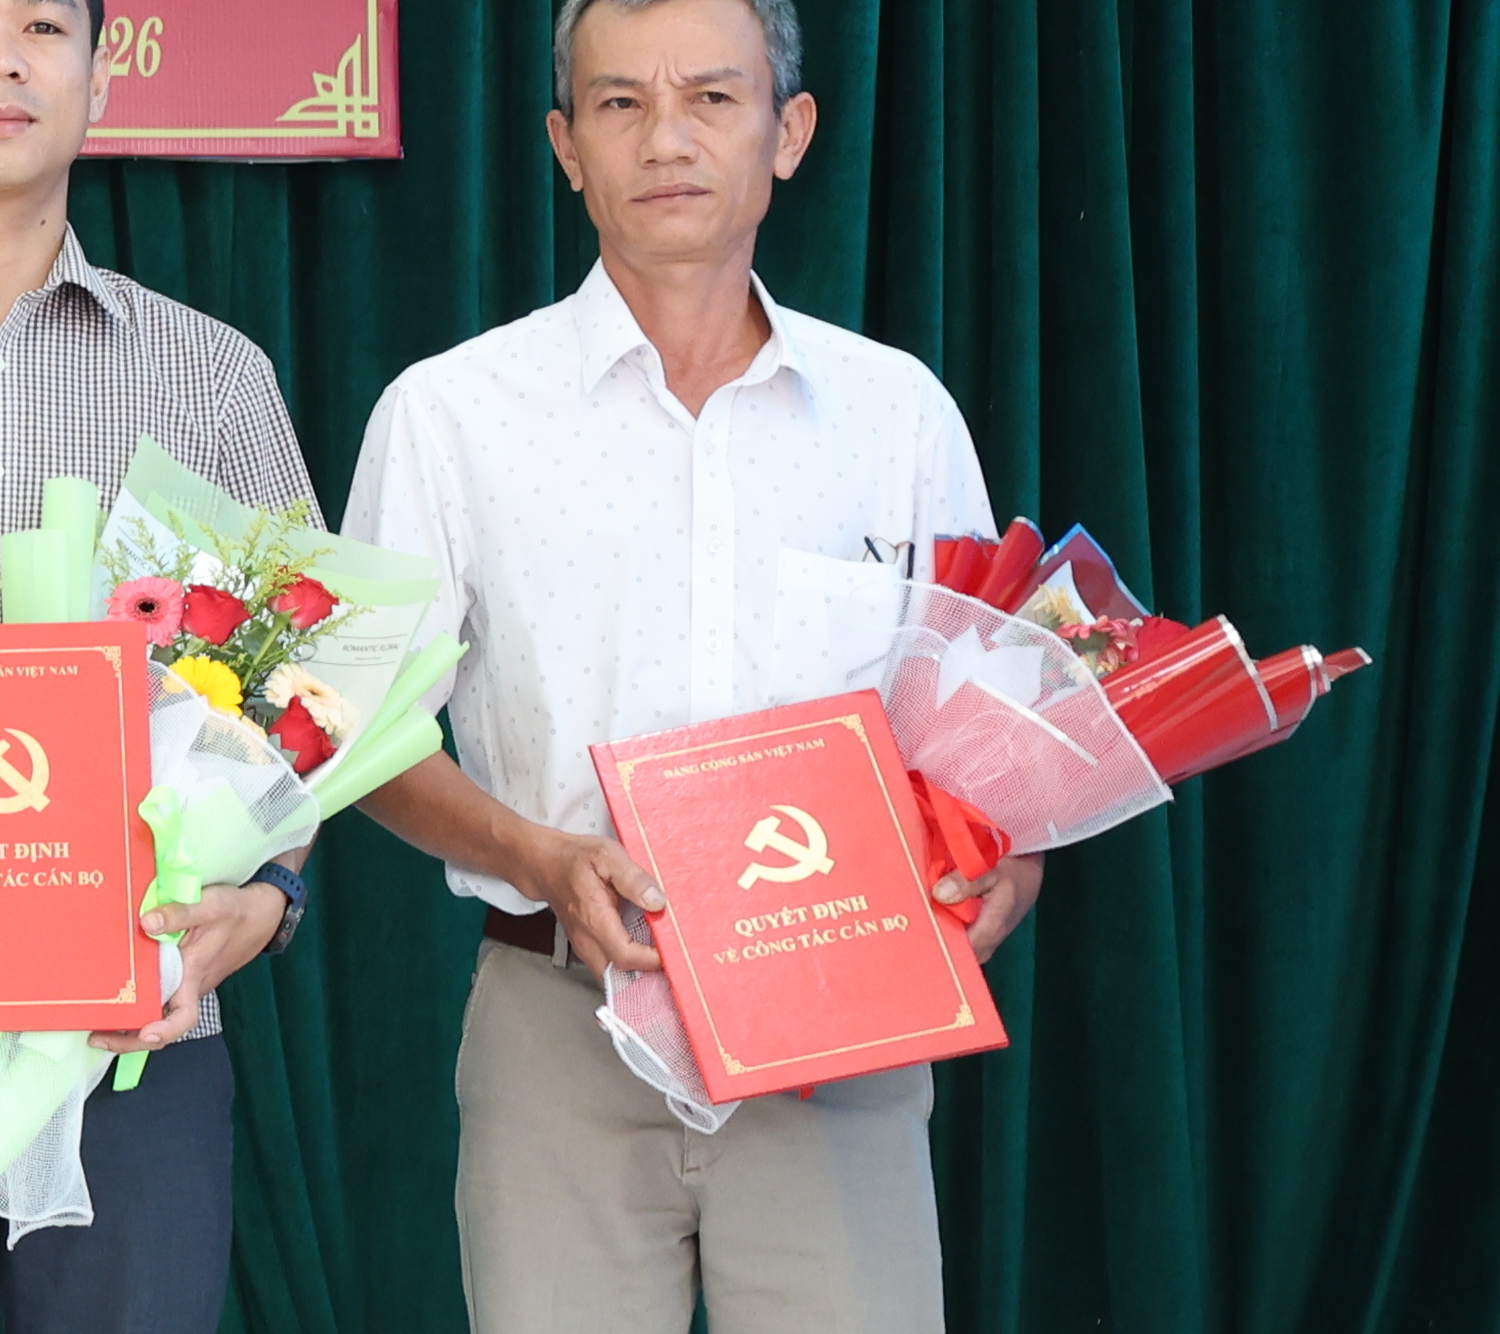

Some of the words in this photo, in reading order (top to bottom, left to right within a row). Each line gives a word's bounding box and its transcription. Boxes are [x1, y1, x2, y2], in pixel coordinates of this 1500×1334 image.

[97, 16, 164, 78] 26
[13, 842, 70, 862] ĐỊNH
[32, 868, 73, 886] CÁN
[77, 869, 104, 888] BỘ
[733, 905, 809, 938] QUYẾT
[810, 894, 869, 921] ĐỊNH
[741, 937, 797, 960] CÔNG
[797, 928, 837, 949] TÁC
[838, 919, 879, 940] CÁN
[880, 912, 909, 932] BỘ
